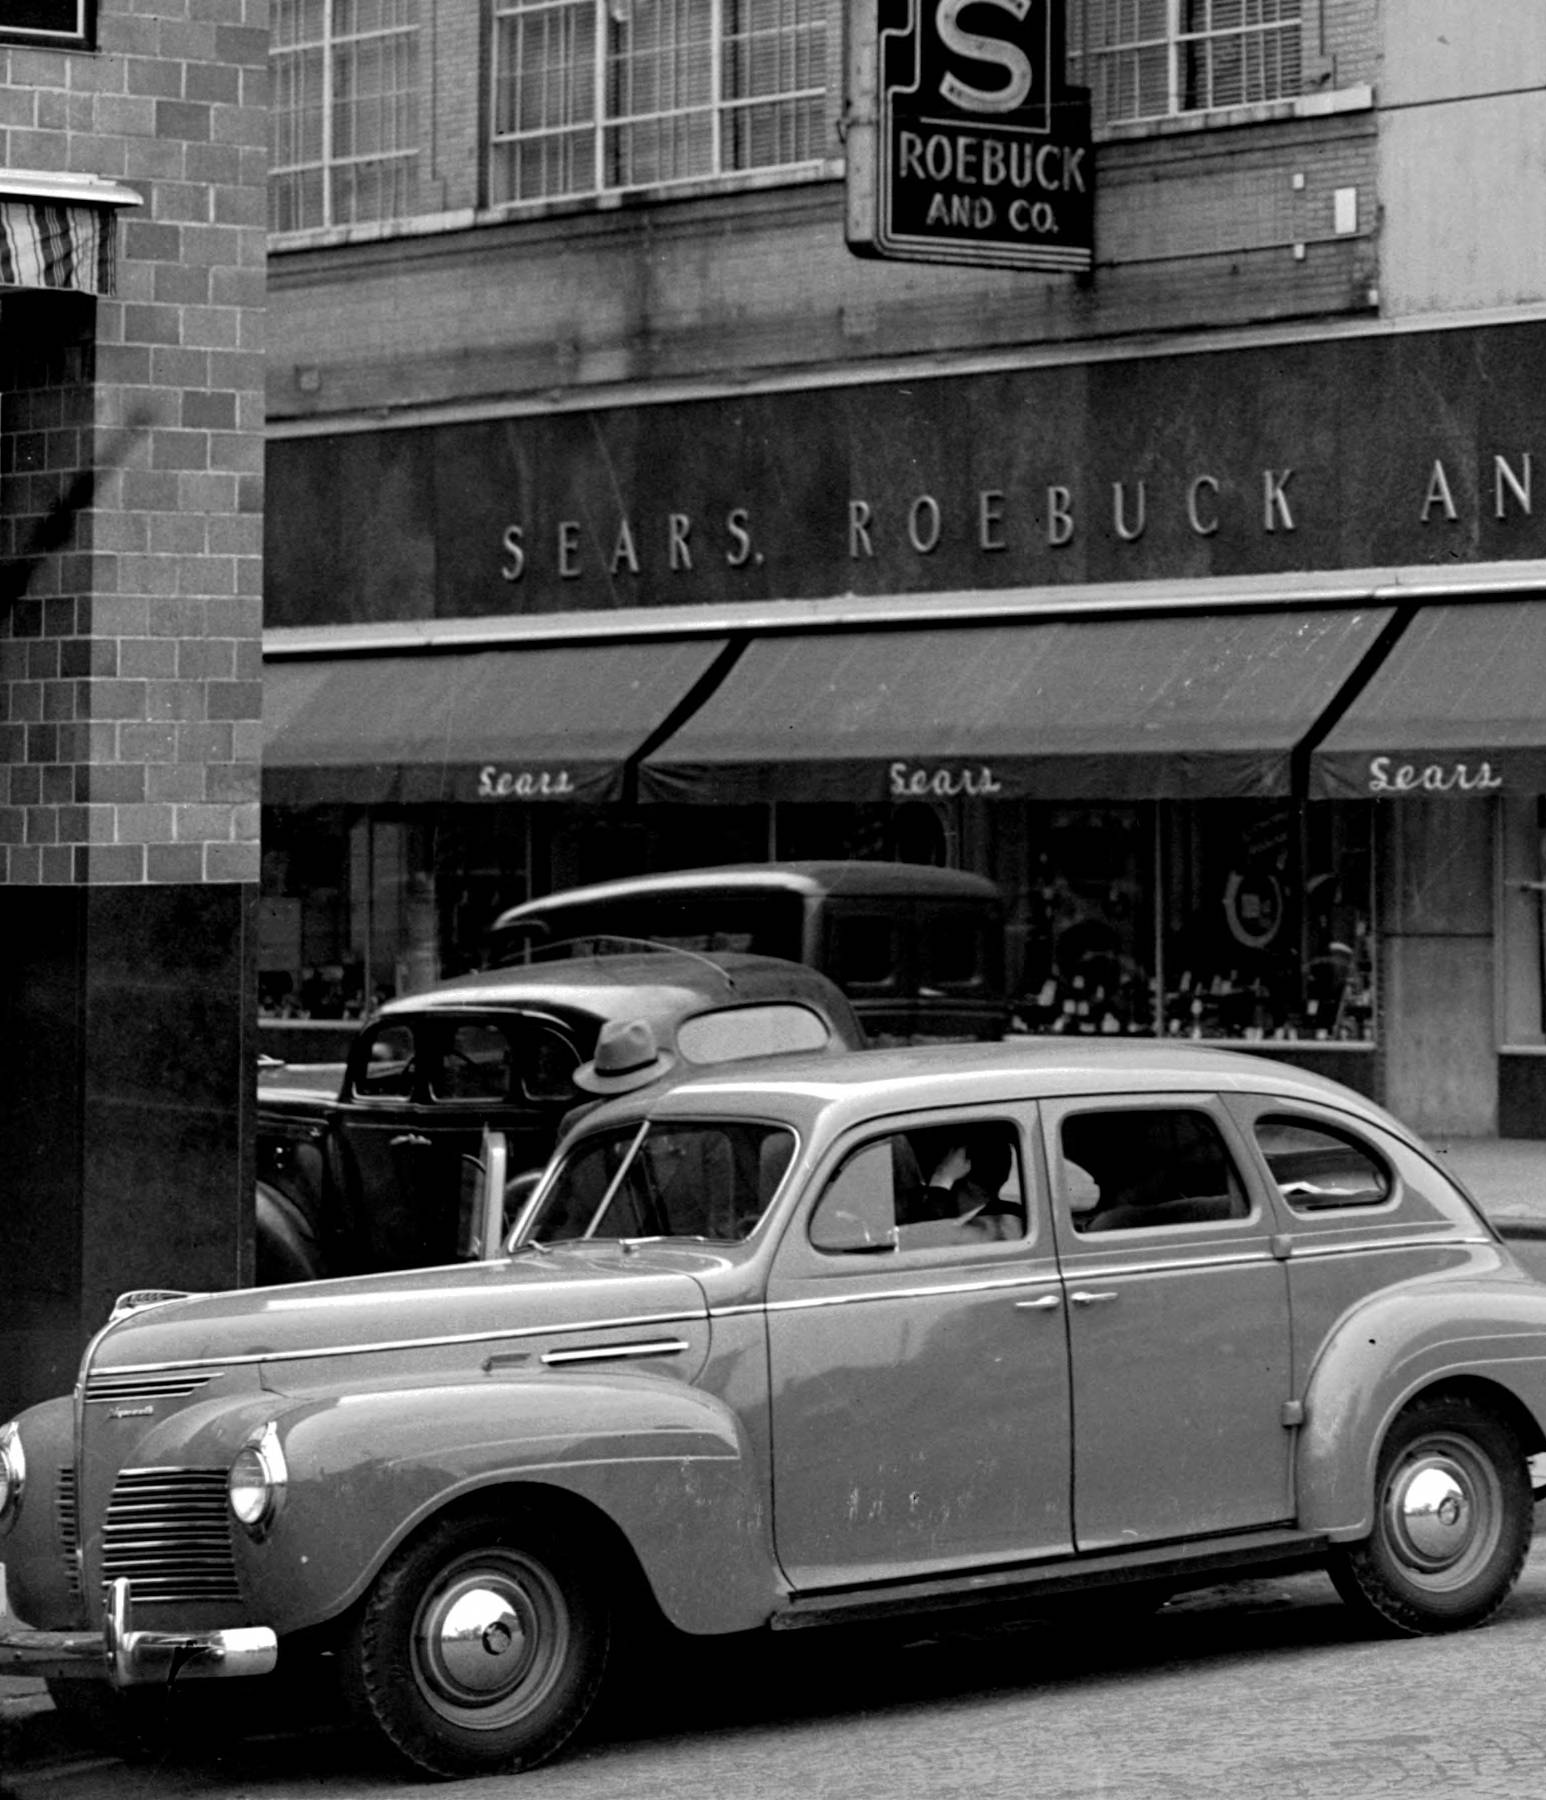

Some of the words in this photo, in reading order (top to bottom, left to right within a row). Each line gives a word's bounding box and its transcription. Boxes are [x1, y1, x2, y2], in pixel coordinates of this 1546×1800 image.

[900, 131, 1086, 192] ROEBUCK
[926, 192, 994, 229] AND
[1008, 199, 1059, 233] CO.
[847, 467, 1297, 559] ROEBUCK
[478, 765, 574, 797] Sears
[890, 762, 1001, 795] Sears
[1368, 756, 1502, 791] Sears
